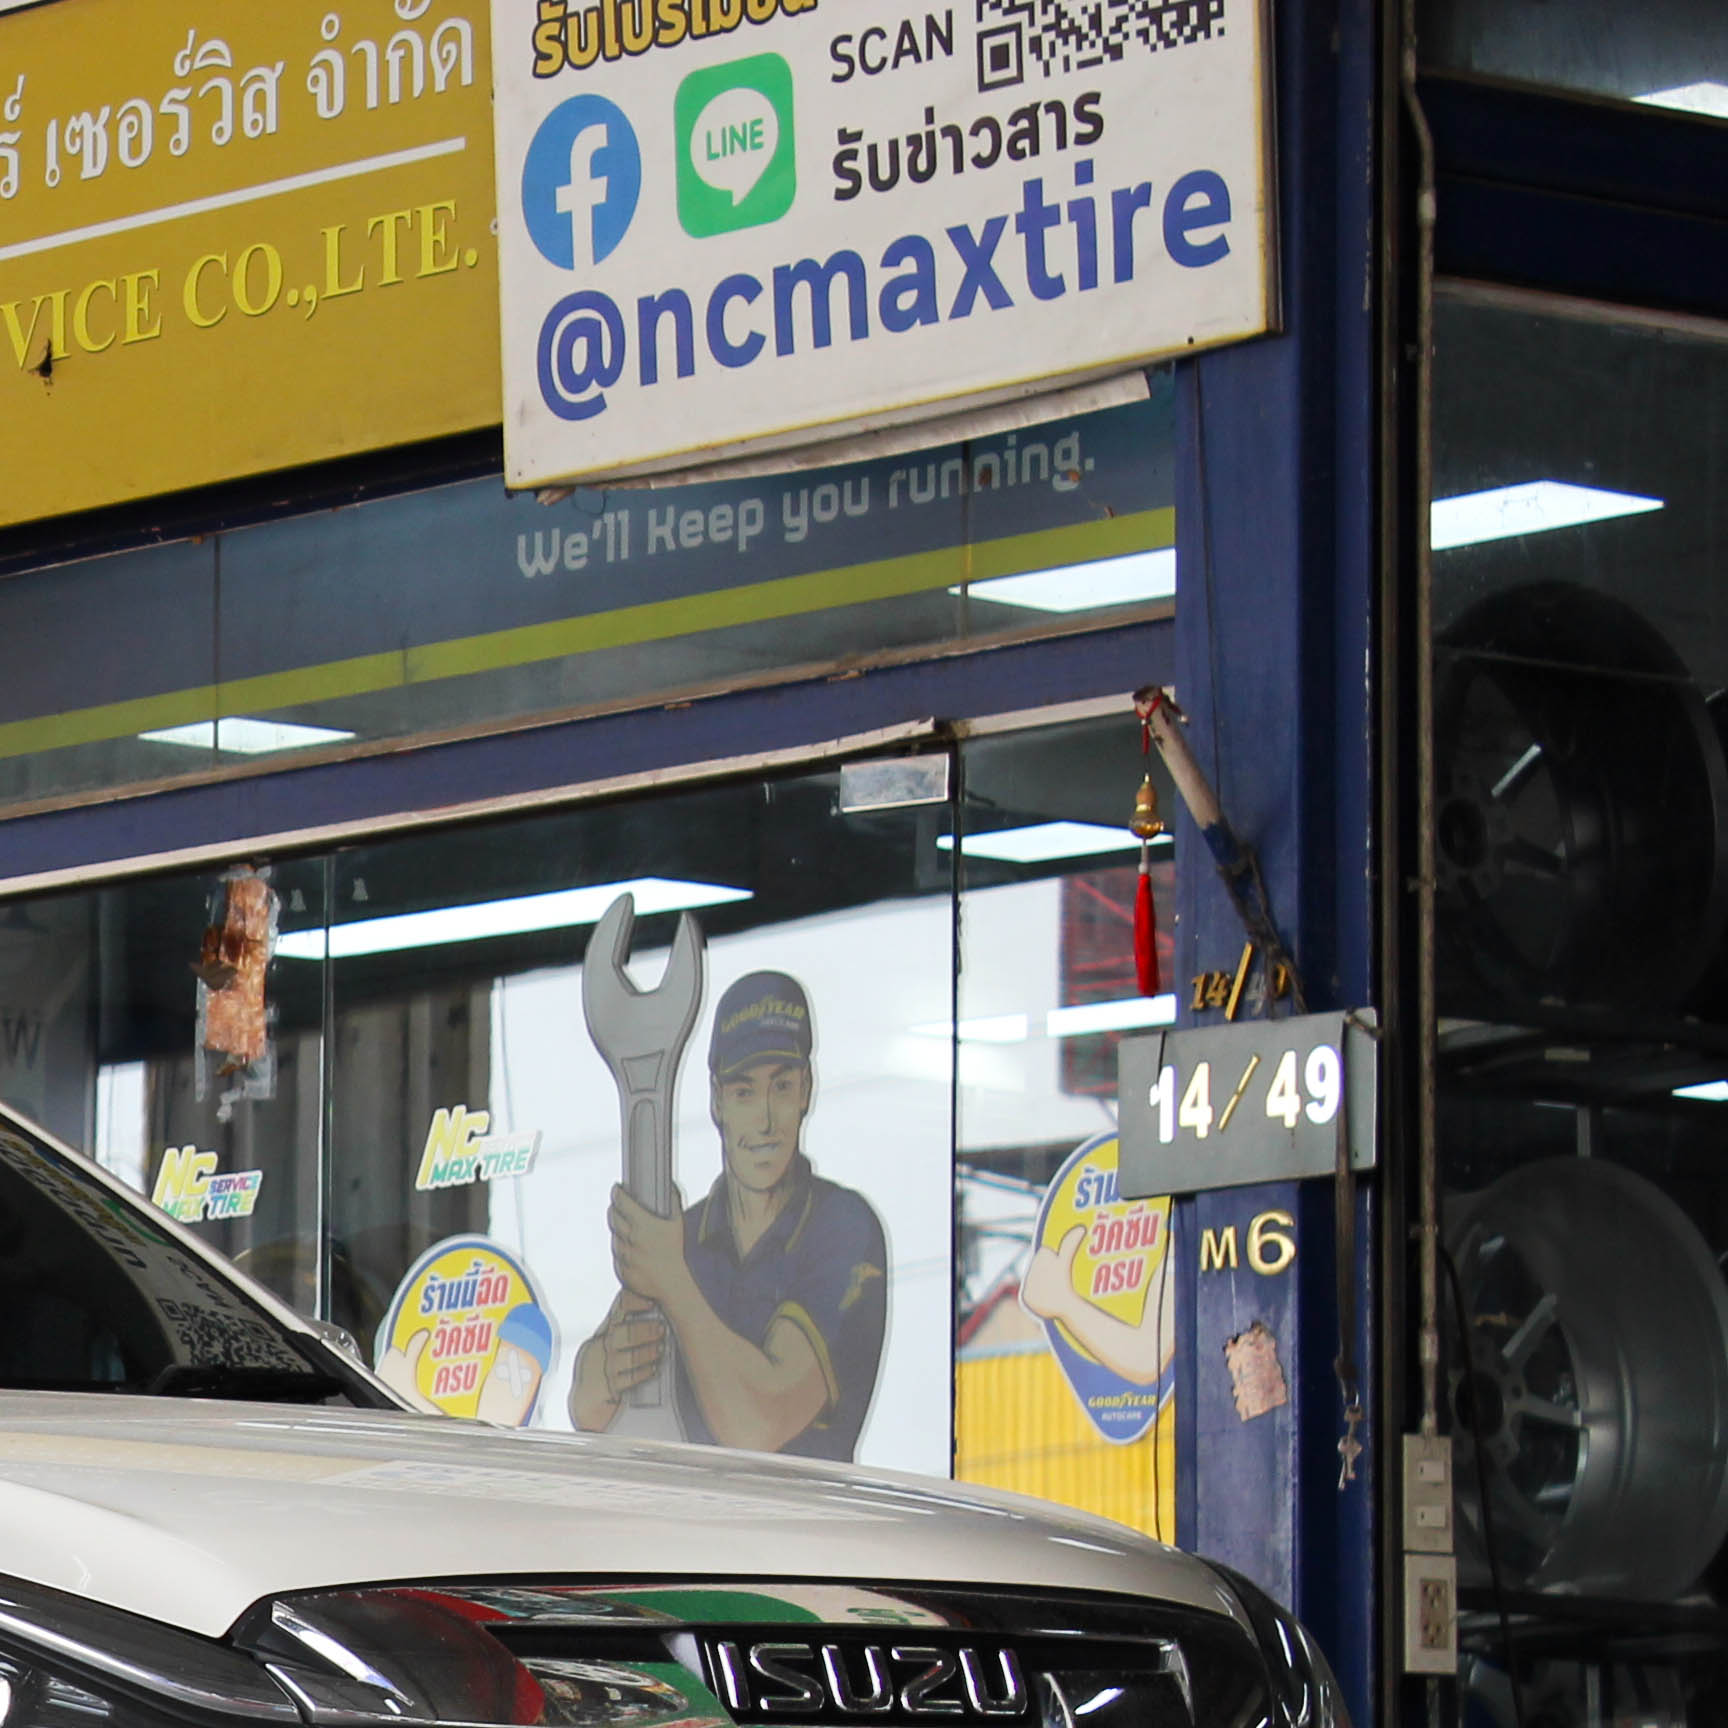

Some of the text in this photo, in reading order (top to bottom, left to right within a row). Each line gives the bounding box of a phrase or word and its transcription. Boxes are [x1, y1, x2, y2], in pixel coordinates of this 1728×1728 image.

[831, 9, 955, 83] SCAN
[45, 28, 285, 188] เซอร์วิส
[306, 0, 474, 119] จำกัด
[704, 118, 764, 161] LINE
[833, 91, 1105, 201] รับข่าวสาร
[537, 158, 1232, 421] @ncmaxtire
[517, 509, 631, 579] We'll
[781, 475, 870, 542] you
[888, 431, 1095, 510] running.
[1149, 1044, 1342, 1144] 14/49
[154, 1148, 218, 1206] NC
[418, 1109, 489, 1187] NC
[431, 1144, 531, 1185] MAX TIRE
[207, 1189, 256, 1218] TIRE
[208, 1173, 261, 1196] SERVICE
[1089, 1204, 1160, 1257] วัคซีน
[1092, 1256, 1144, 1296] ครบ
[432, 1313, 493, 1358] วัคซีน
[434, 1361, 480, 1396] ครบ
[716, 1640, 1028, 1717] ISUZU
